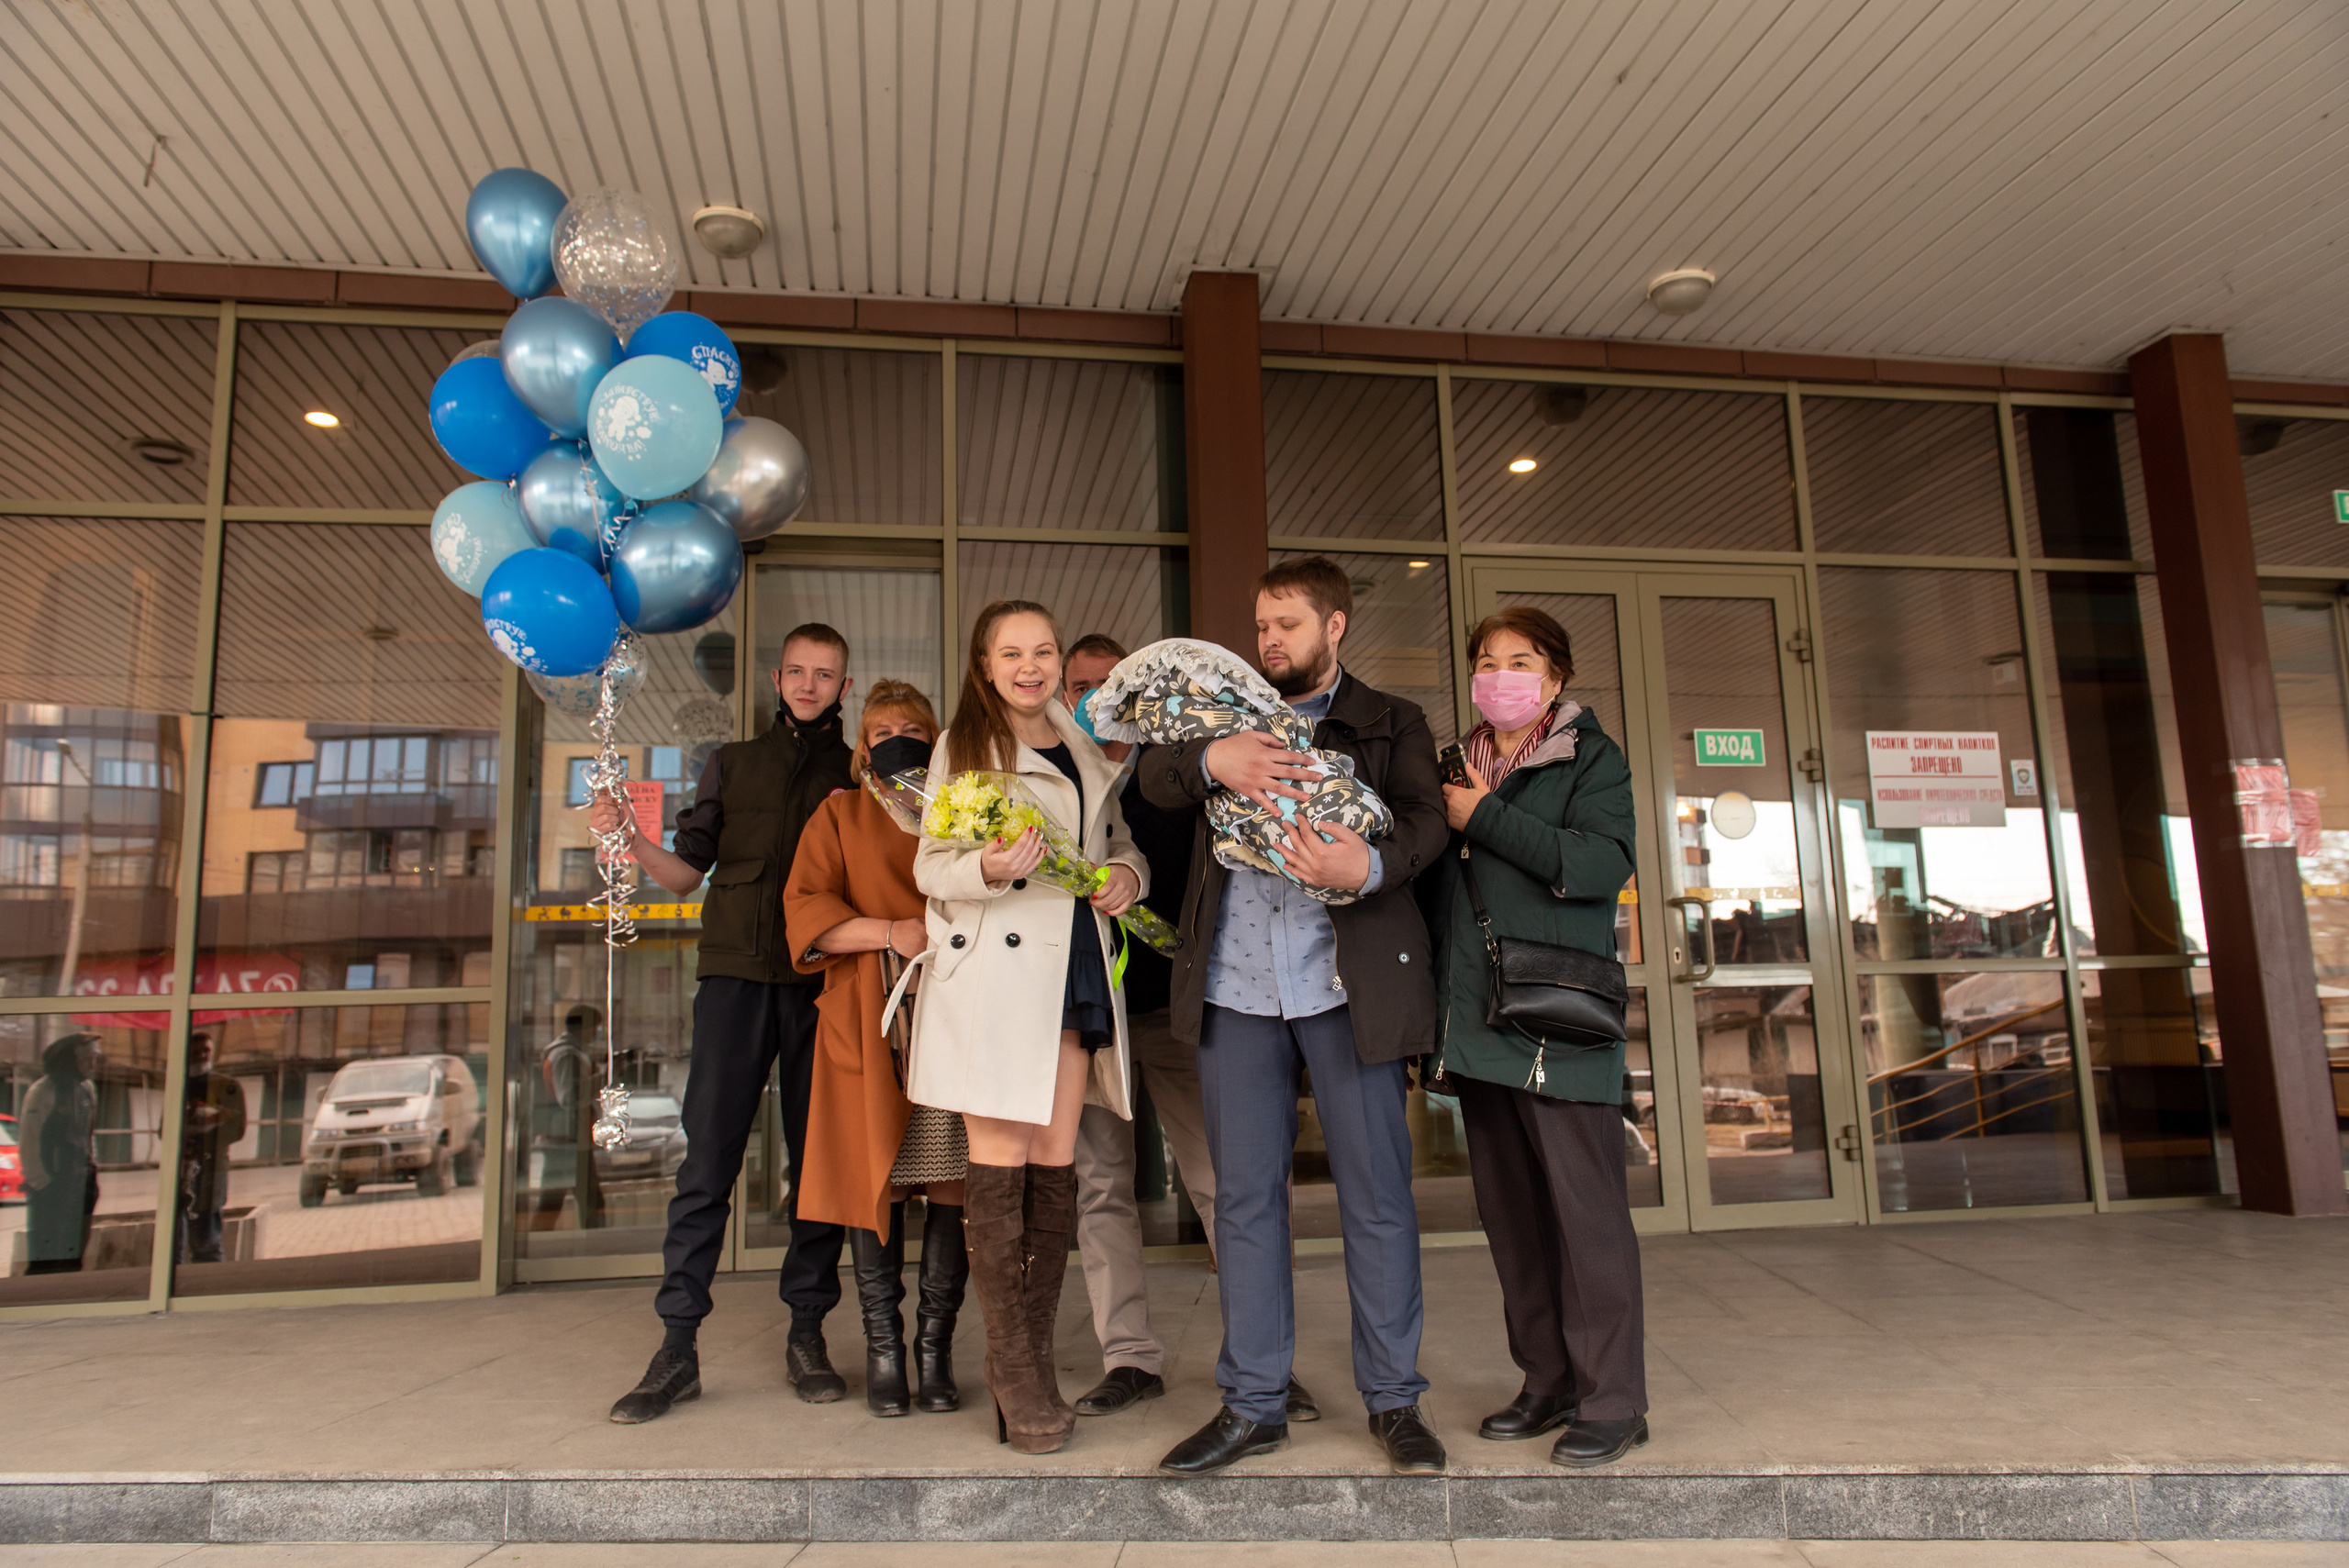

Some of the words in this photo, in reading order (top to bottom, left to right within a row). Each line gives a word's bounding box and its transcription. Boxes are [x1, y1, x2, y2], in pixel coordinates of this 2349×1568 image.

[1705, 735, 1755, 761] ВХОД
[1871, 737, 1909, 750] РАСПИТИЕ
[1913, 738, 1954, 750] СПИРТНЫХ
[1958, 738, 1996, 751] НАПИТКОВ
[1910, 756, 1963, 775] ЗАПРЕЩЕНО
[1877, 788, 1922, 801] ИСПОЛЬЗОВАНИЕ
